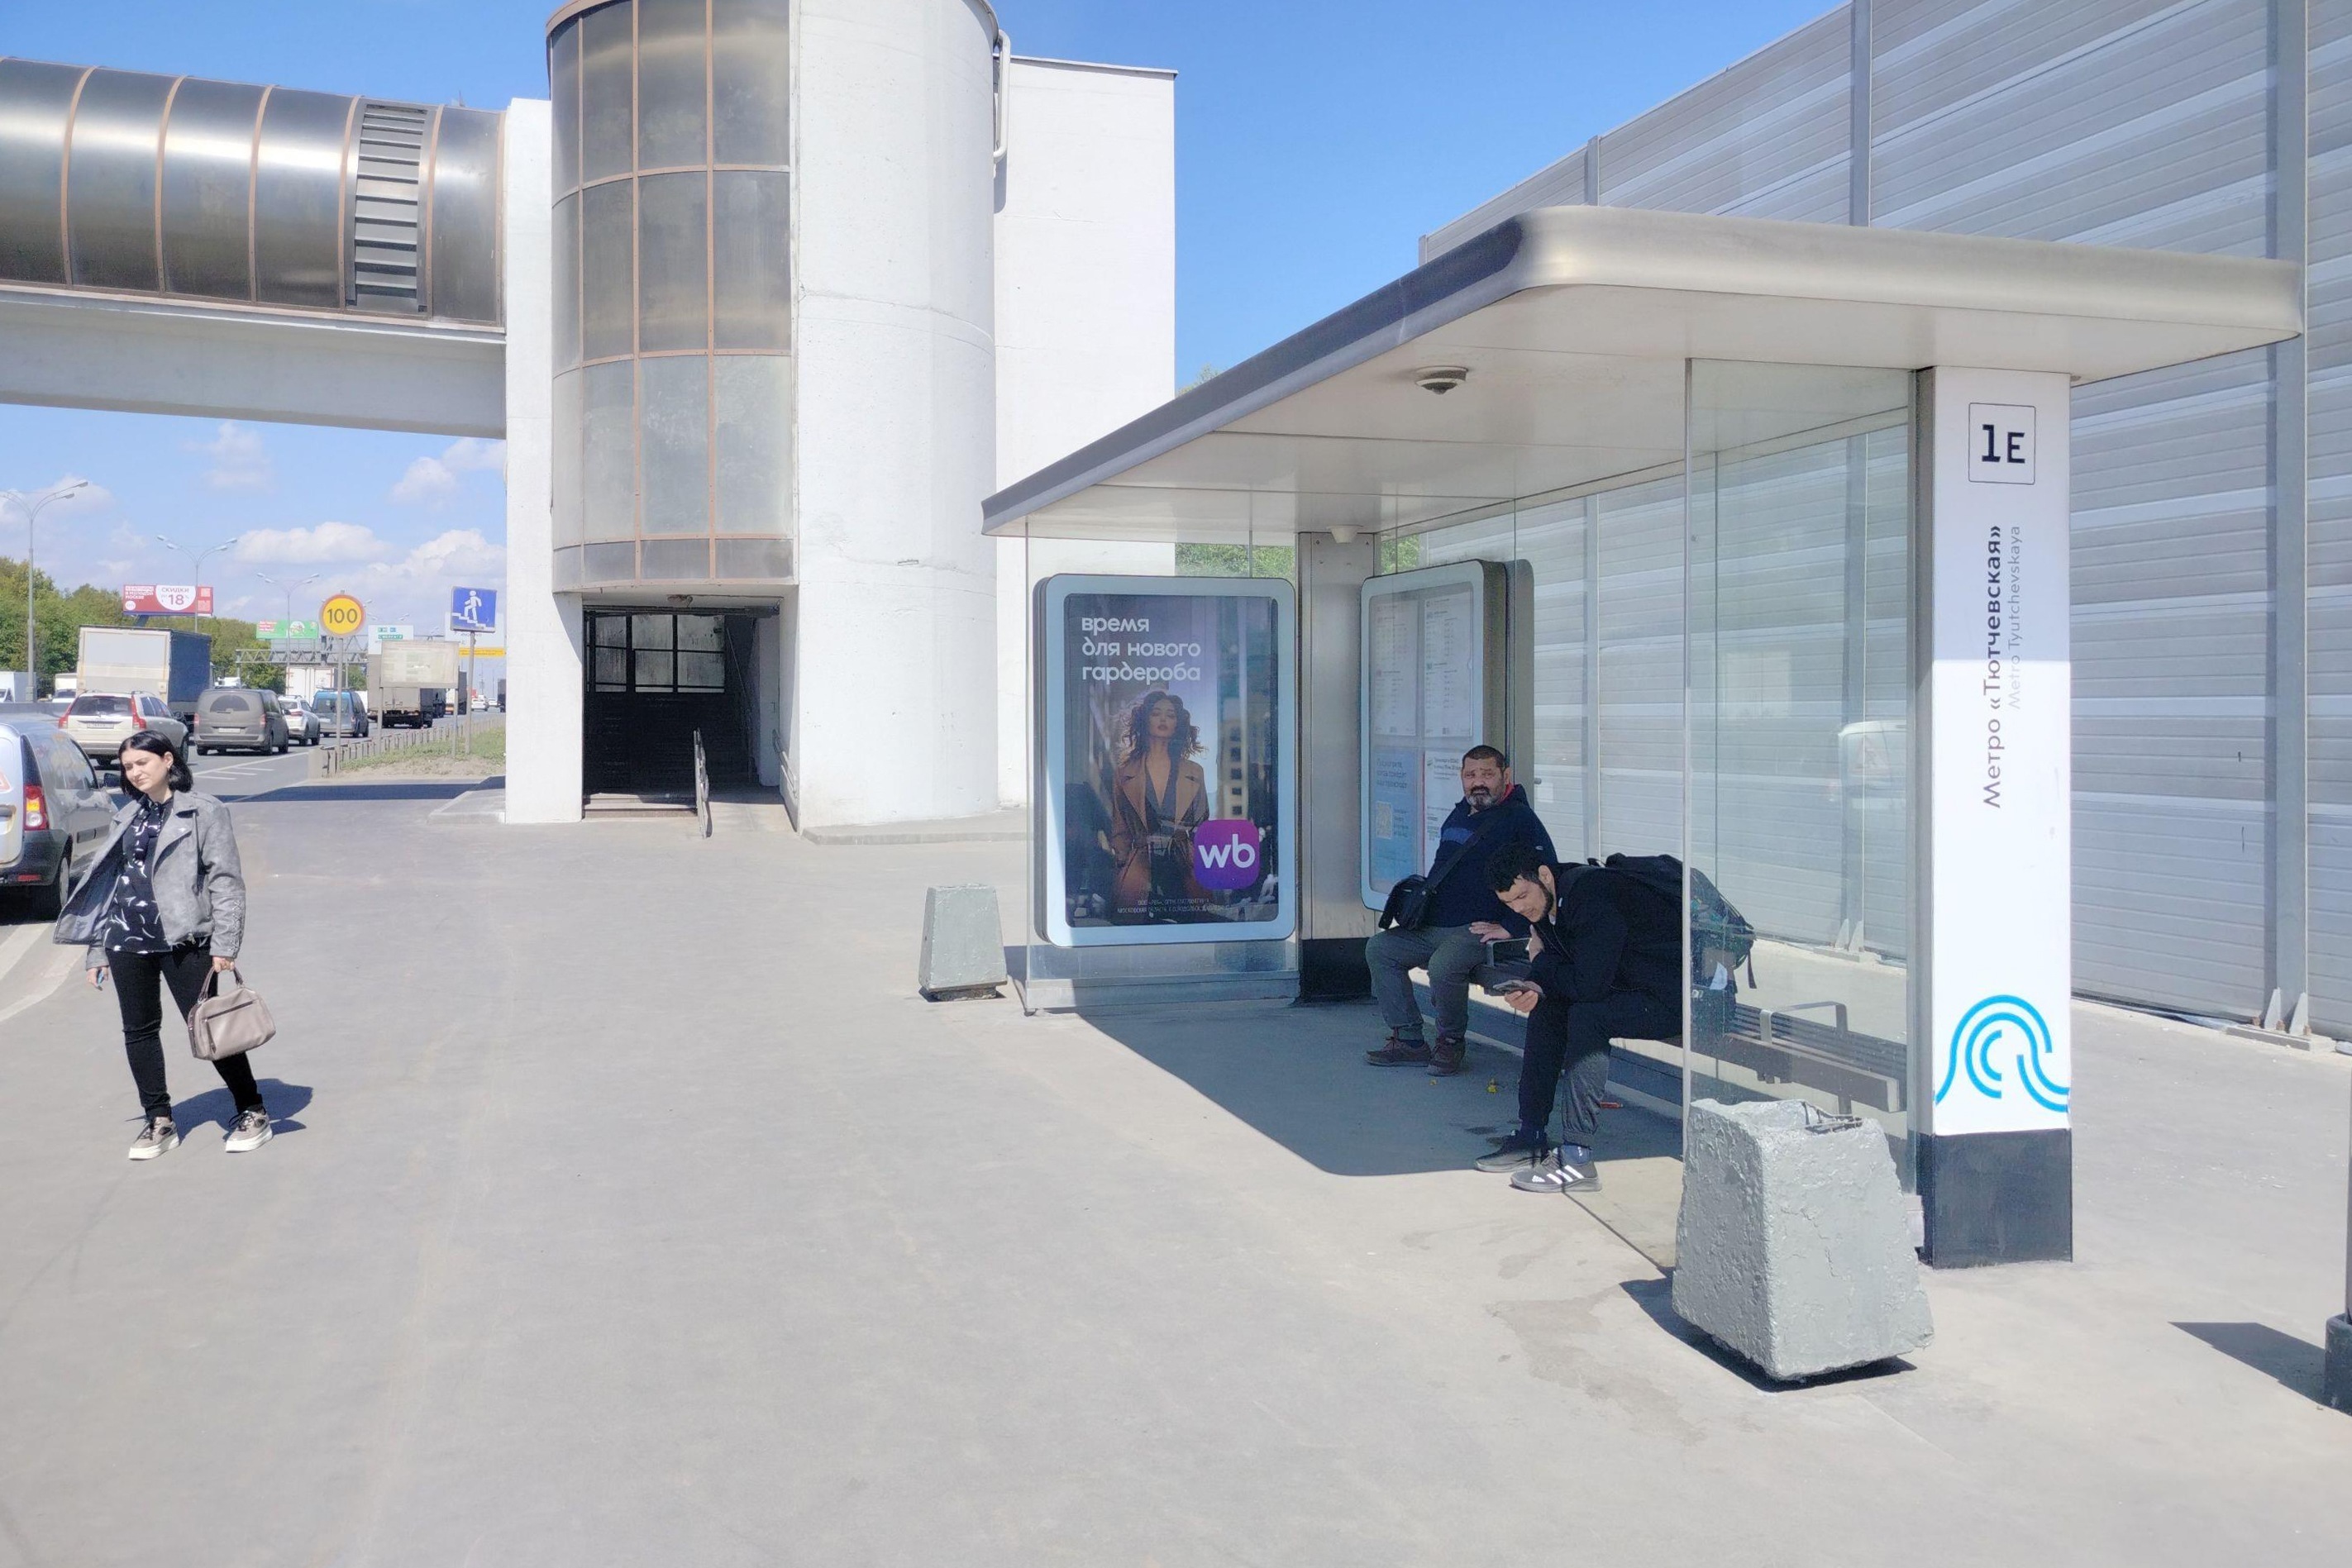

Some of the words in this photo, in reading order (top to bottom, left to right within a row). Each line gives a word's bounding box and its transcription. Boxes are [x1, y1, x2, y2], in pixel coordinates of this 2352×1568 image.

[168, 594, 184, 606] 18
[2007, 526, 2023, 650] Tyutchevskaya
[327, 608, 358, 624] 100
[1081, 616, 1150, 636] время
[1983, 526, 2001, 710] «Тютчевская»
[1081, 636, 1120, 656] для
[1127, 641, 1201, 657] нового
[1081, 661, 1201, 685] гардероба
[2008, 655, 2020, 710] Metro
[1983, 718, 2005, 808] Метро
[1199, 833, 1256, 869] wb
